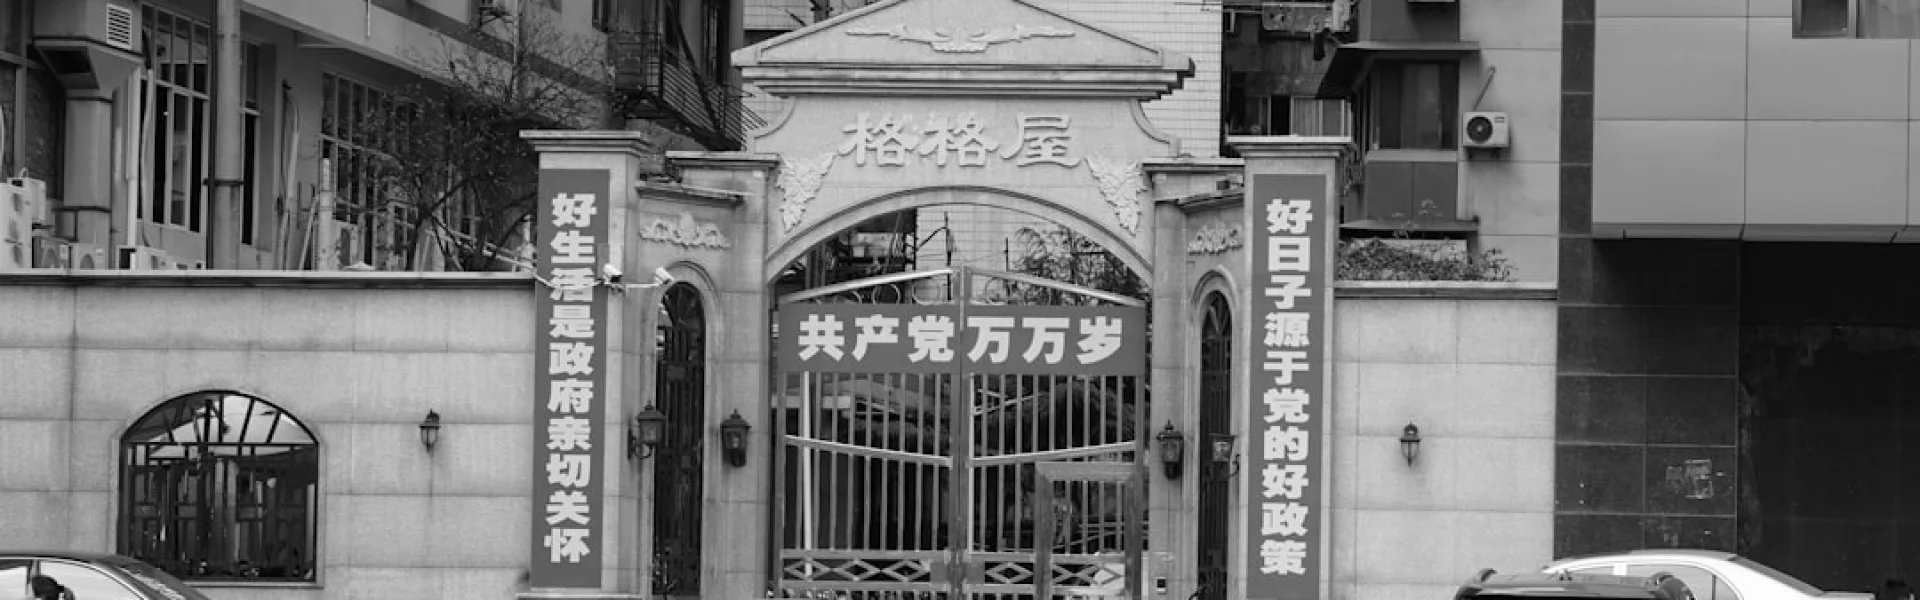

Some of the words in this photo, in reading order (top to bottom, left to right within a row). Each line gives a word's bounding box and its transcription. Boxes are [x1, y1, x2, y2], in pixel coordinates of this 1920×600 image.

[838, 111, 1082, 167] 格格屋
[544, 193, 597, 563] 好生活是政府亲切关怀
[798, 313, 1123, 365] 共产党万万岁
[1260, 199, 1313, 576] 好日子源于党的好政策
